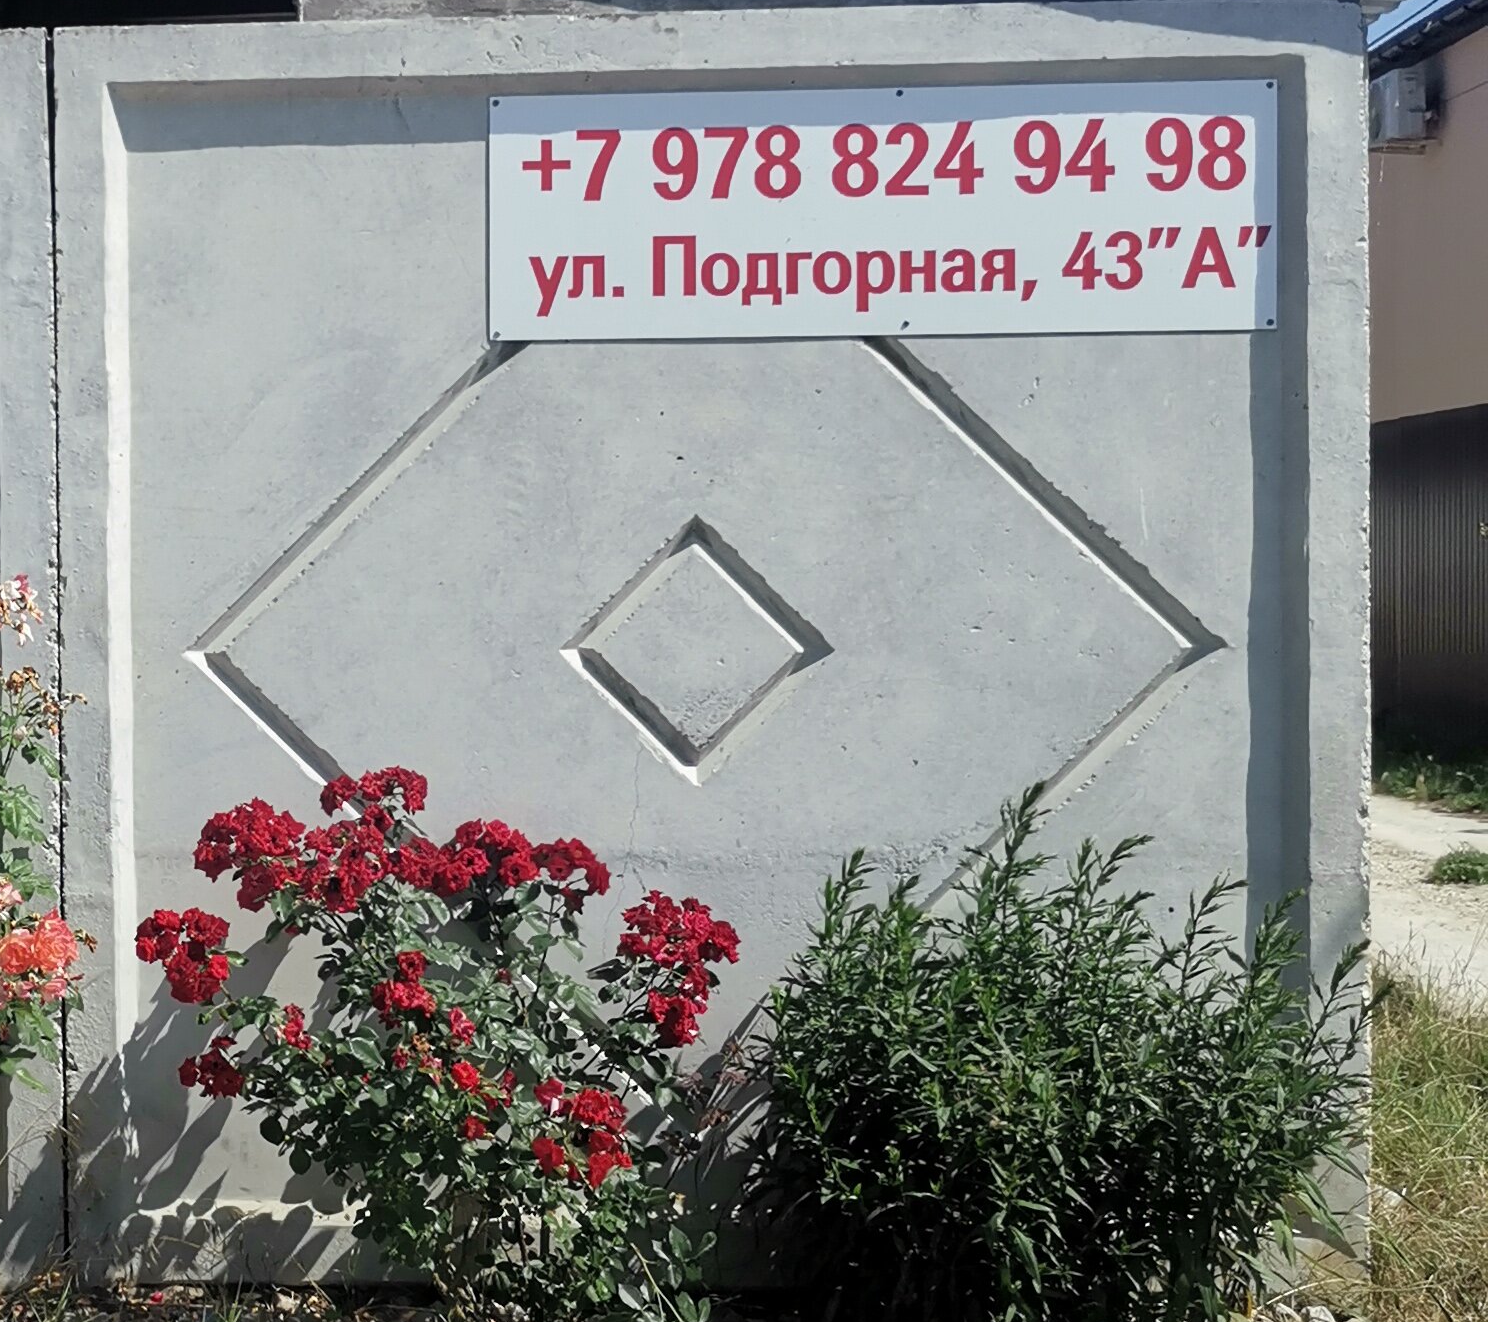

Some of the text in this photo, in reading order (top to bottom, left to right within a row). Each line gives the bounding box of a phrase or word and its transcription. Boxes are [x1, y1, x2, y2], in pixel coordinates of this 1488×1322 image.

[522, 116, 1246, 202] +7 978 824 94 98
[530, 255, 625, 317] ул.
[652, 235, 1037, 313] Подгорная,
